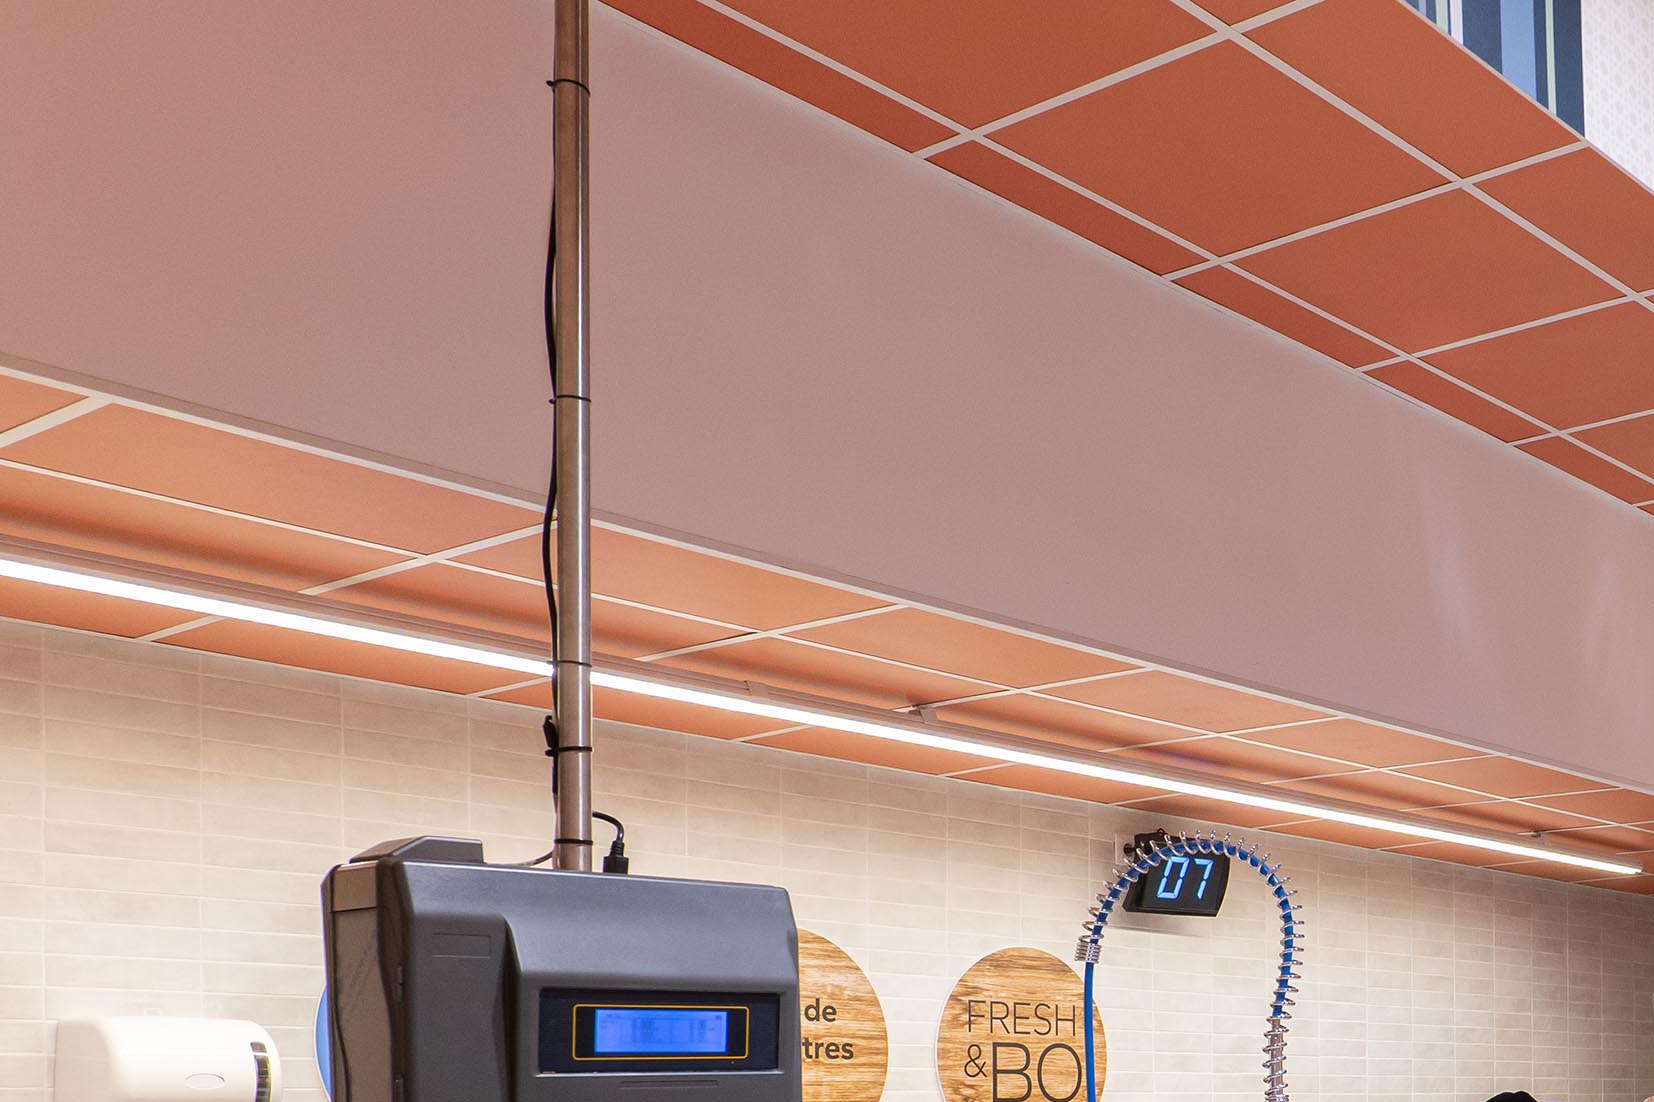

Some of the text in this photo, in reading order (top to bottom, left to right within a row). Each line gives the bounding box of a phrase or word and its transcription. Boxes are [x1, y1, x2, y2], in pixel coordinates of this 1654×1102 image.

[1156, 856, 1214, 899] 07
[803, 998, 837, 1022] de
[967, 999, 1077, 1036] FRESH
